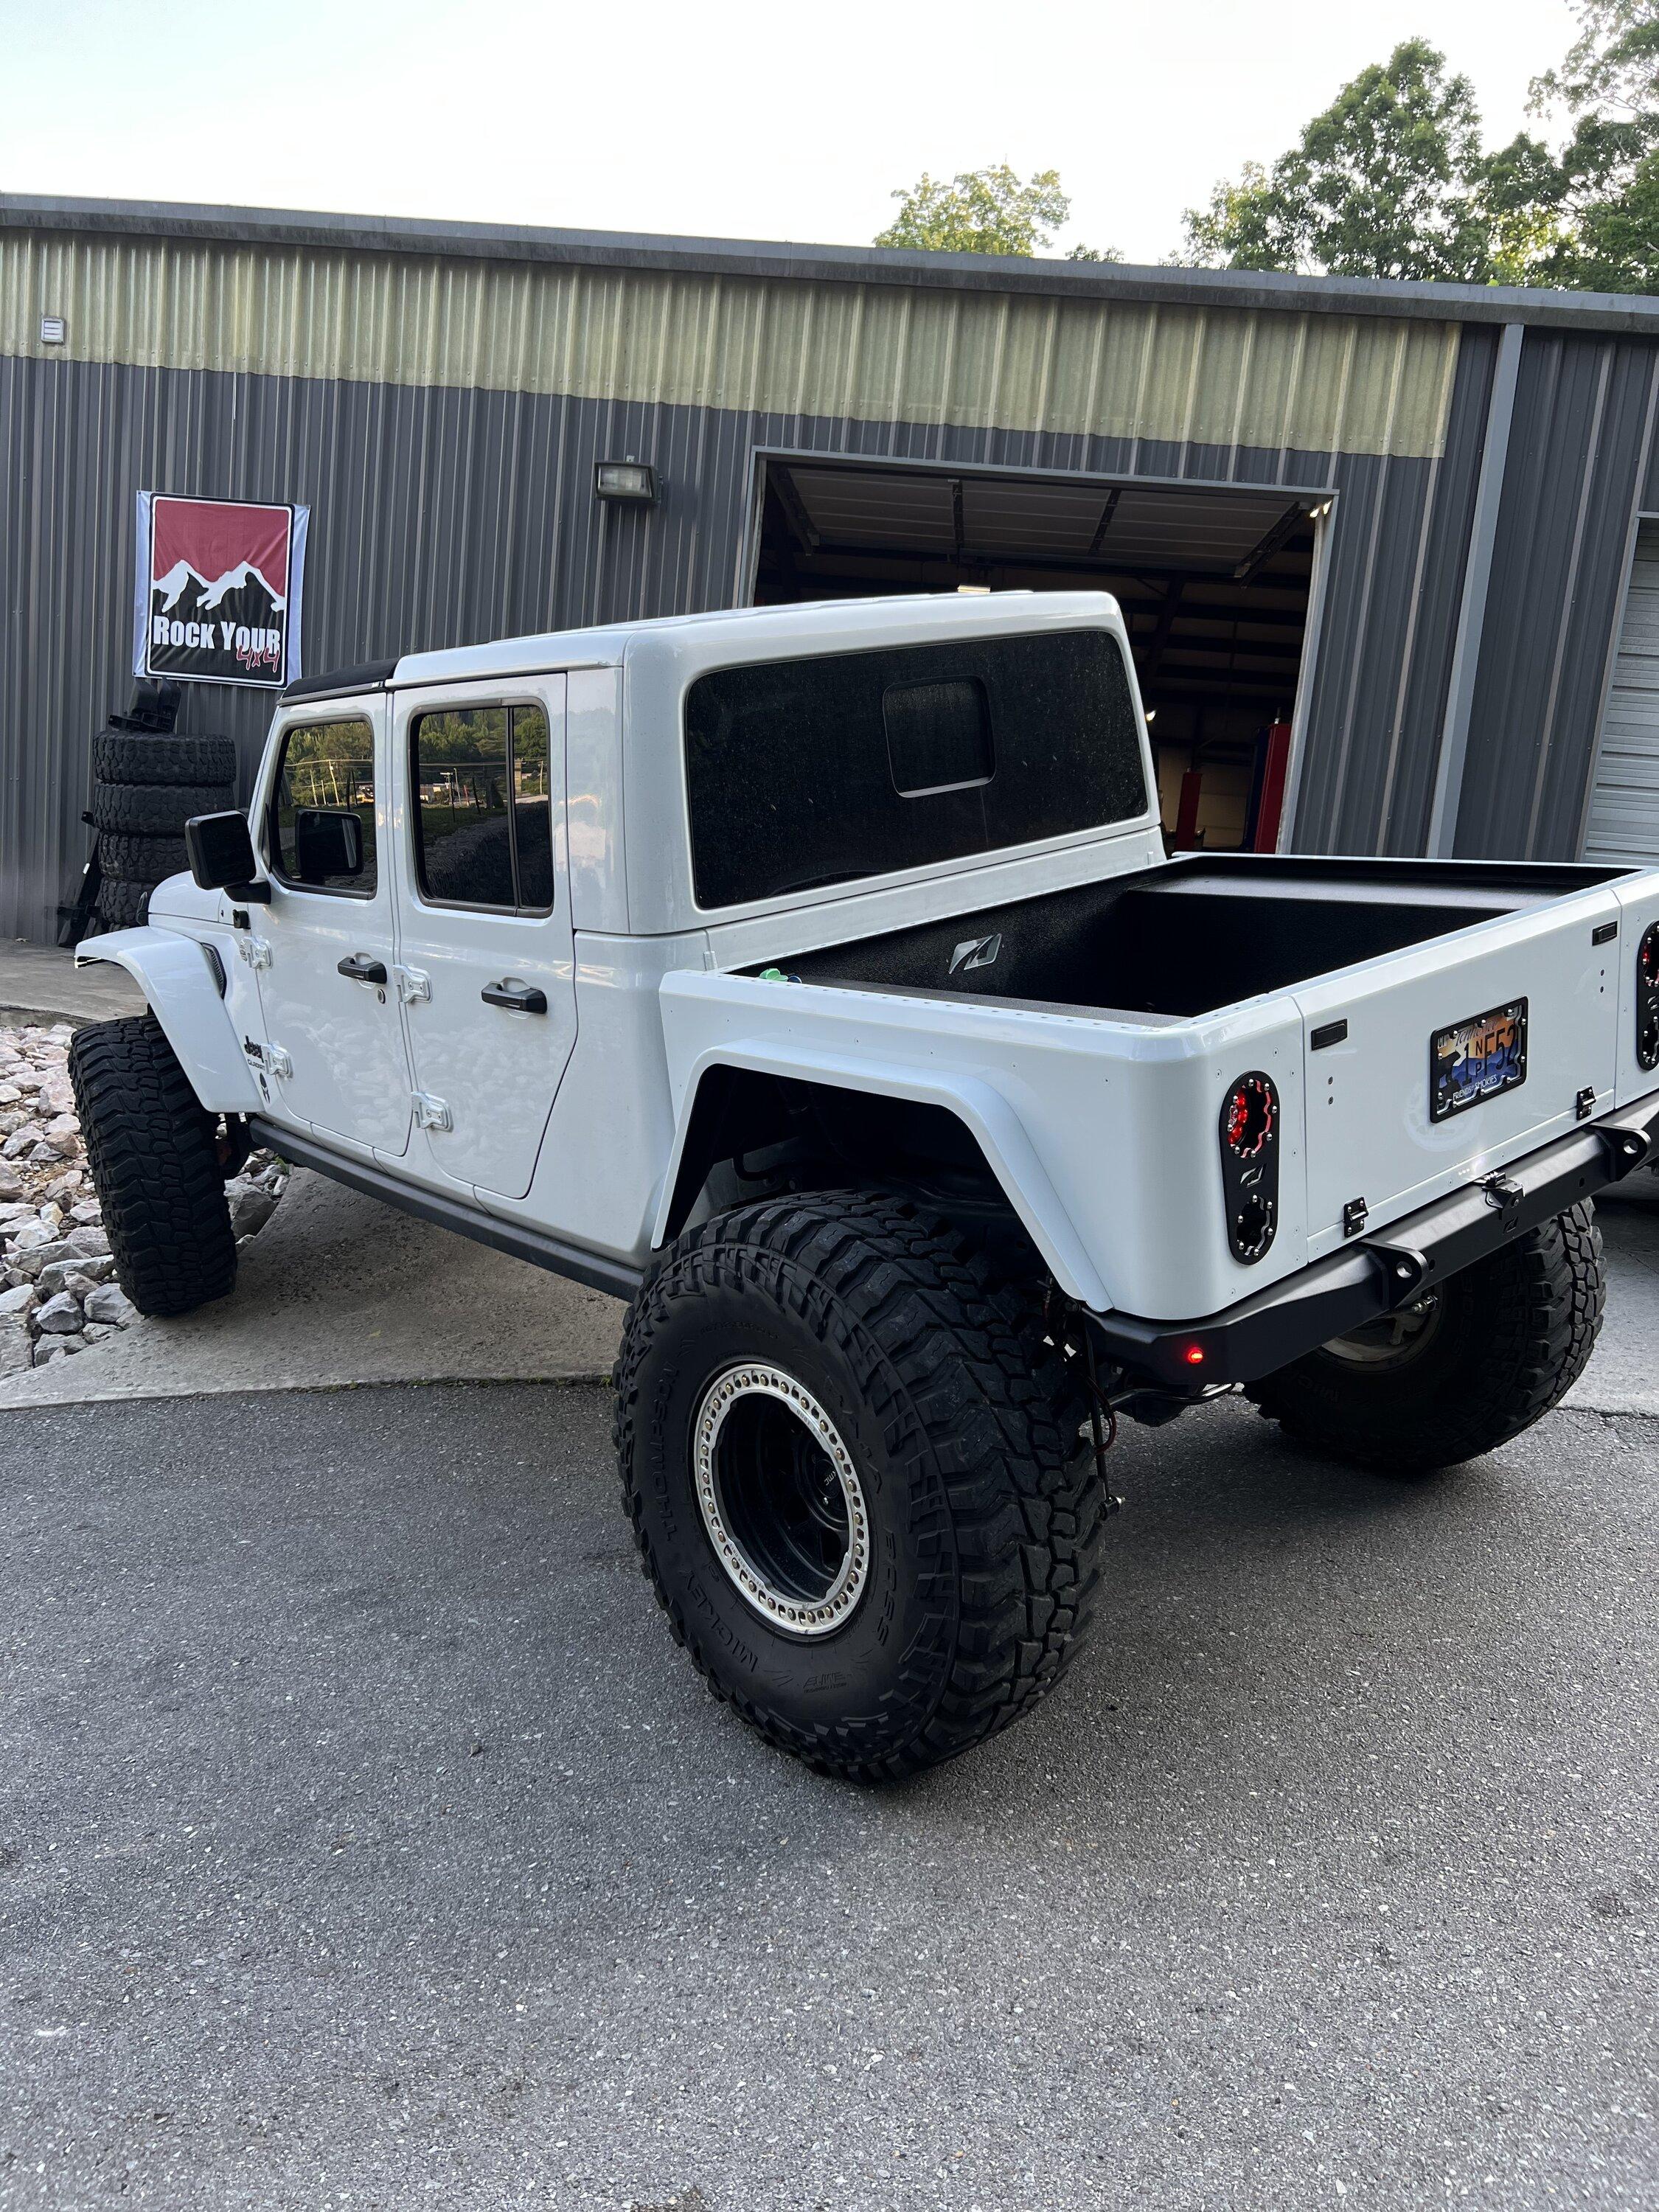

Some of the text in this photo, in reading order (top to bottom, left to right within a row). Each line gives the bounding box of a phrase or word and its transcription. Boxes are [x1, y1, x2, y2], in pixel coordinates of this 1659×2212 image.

[153, 615, 281, 654] ROCK YOUR
[1475, 1074, 1498, 1089] SMOKIES
[680, 1568, 758, 1672] MICKEY
